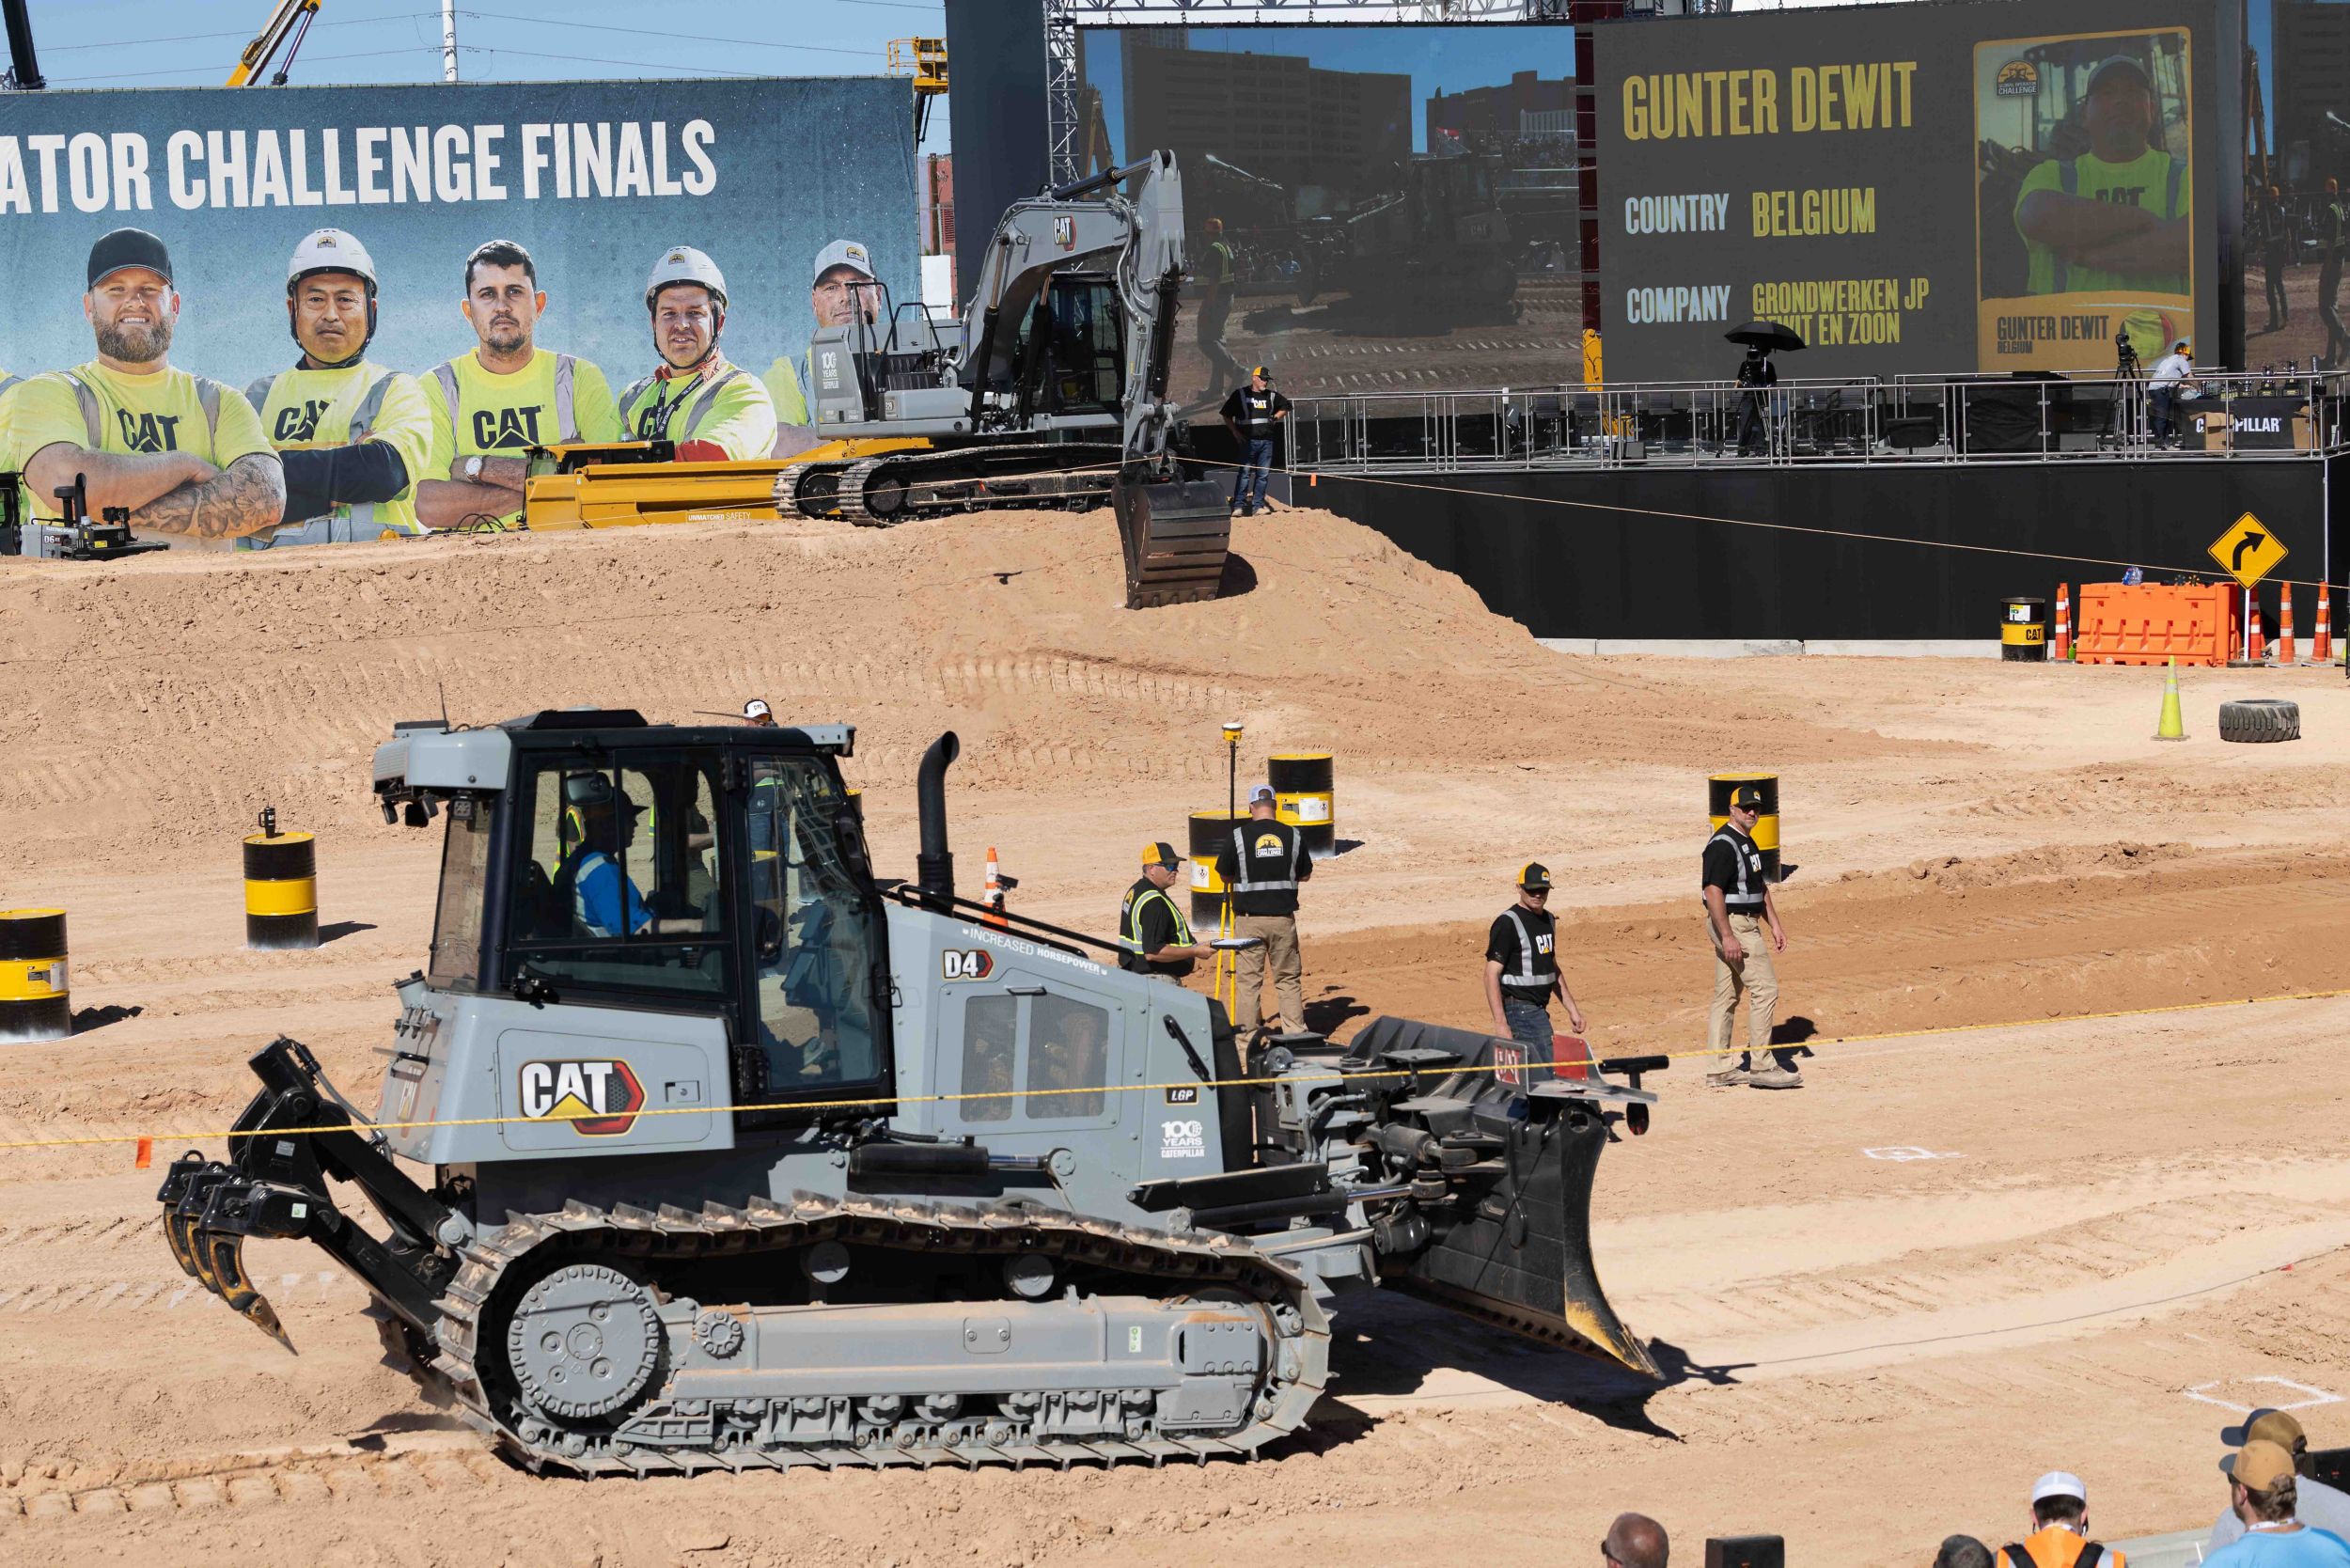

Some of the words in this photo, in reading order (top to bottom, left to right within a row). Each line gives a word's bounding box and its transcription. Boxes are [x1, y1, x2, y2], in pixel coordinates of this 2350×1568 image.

[1622, 69, 1779, 140] GUNTER
[1791, 61, 1917, 132] DEWIT
[0, 133, 153, 214] ATOR
[166, 124, 508, 211] CHALLENGE
[522, 118, 717, 200] FINALS
[1624, 193, 1730, 234] COUNTRY
[1752, 187, 1876, 237] BELGIUM
[1054, 217, 1071, 243] CAT
[1626, 285, 1731, 323] COMPANY
[1752, 278, 1899, 314] GRONDWERKEN
[1904, 277, 1929, 309] JP
[1753, 314, 1813, 345] WIT
[1819, 314, 1843, 345] EN
[1848, 312, 1901, 344] ZOON
[1997, 316, 2057, 340] GUNTER
[2060, 315, 2109, 339] DEWIT
[1998, 341, 2033, 354] BELGIUM
[822, 368, 838, 377] YEARS
[1253, 400, 1267, 409] CAT
[117, 408, 180, 453] CAT
[473, 404, 542, 449] CAT
[2196, 417, 2280, 432] CPILLAR
[726, 511, 751, 520] SAFETY
[2026, 628, 2041, 640] CAT
[970, 928, 1034, 956] INCREASED
[1037, 948, 1100, 973] HORSEPOWER
[1535, 933, 1553, 954] CAT
[944, 950, 979, 978] D4
[1495, 1045, 1520, 1085] CAT
[522, 1062, 613, 1118] CAT
[1171, 1090, 1194, 1101] LGP
[1161, 1121, 1203, 1137] 100
[1161, 1148, 1205, 1158] CATERPILLAR
[1162, 1137, 1202, 1147] YEARS
